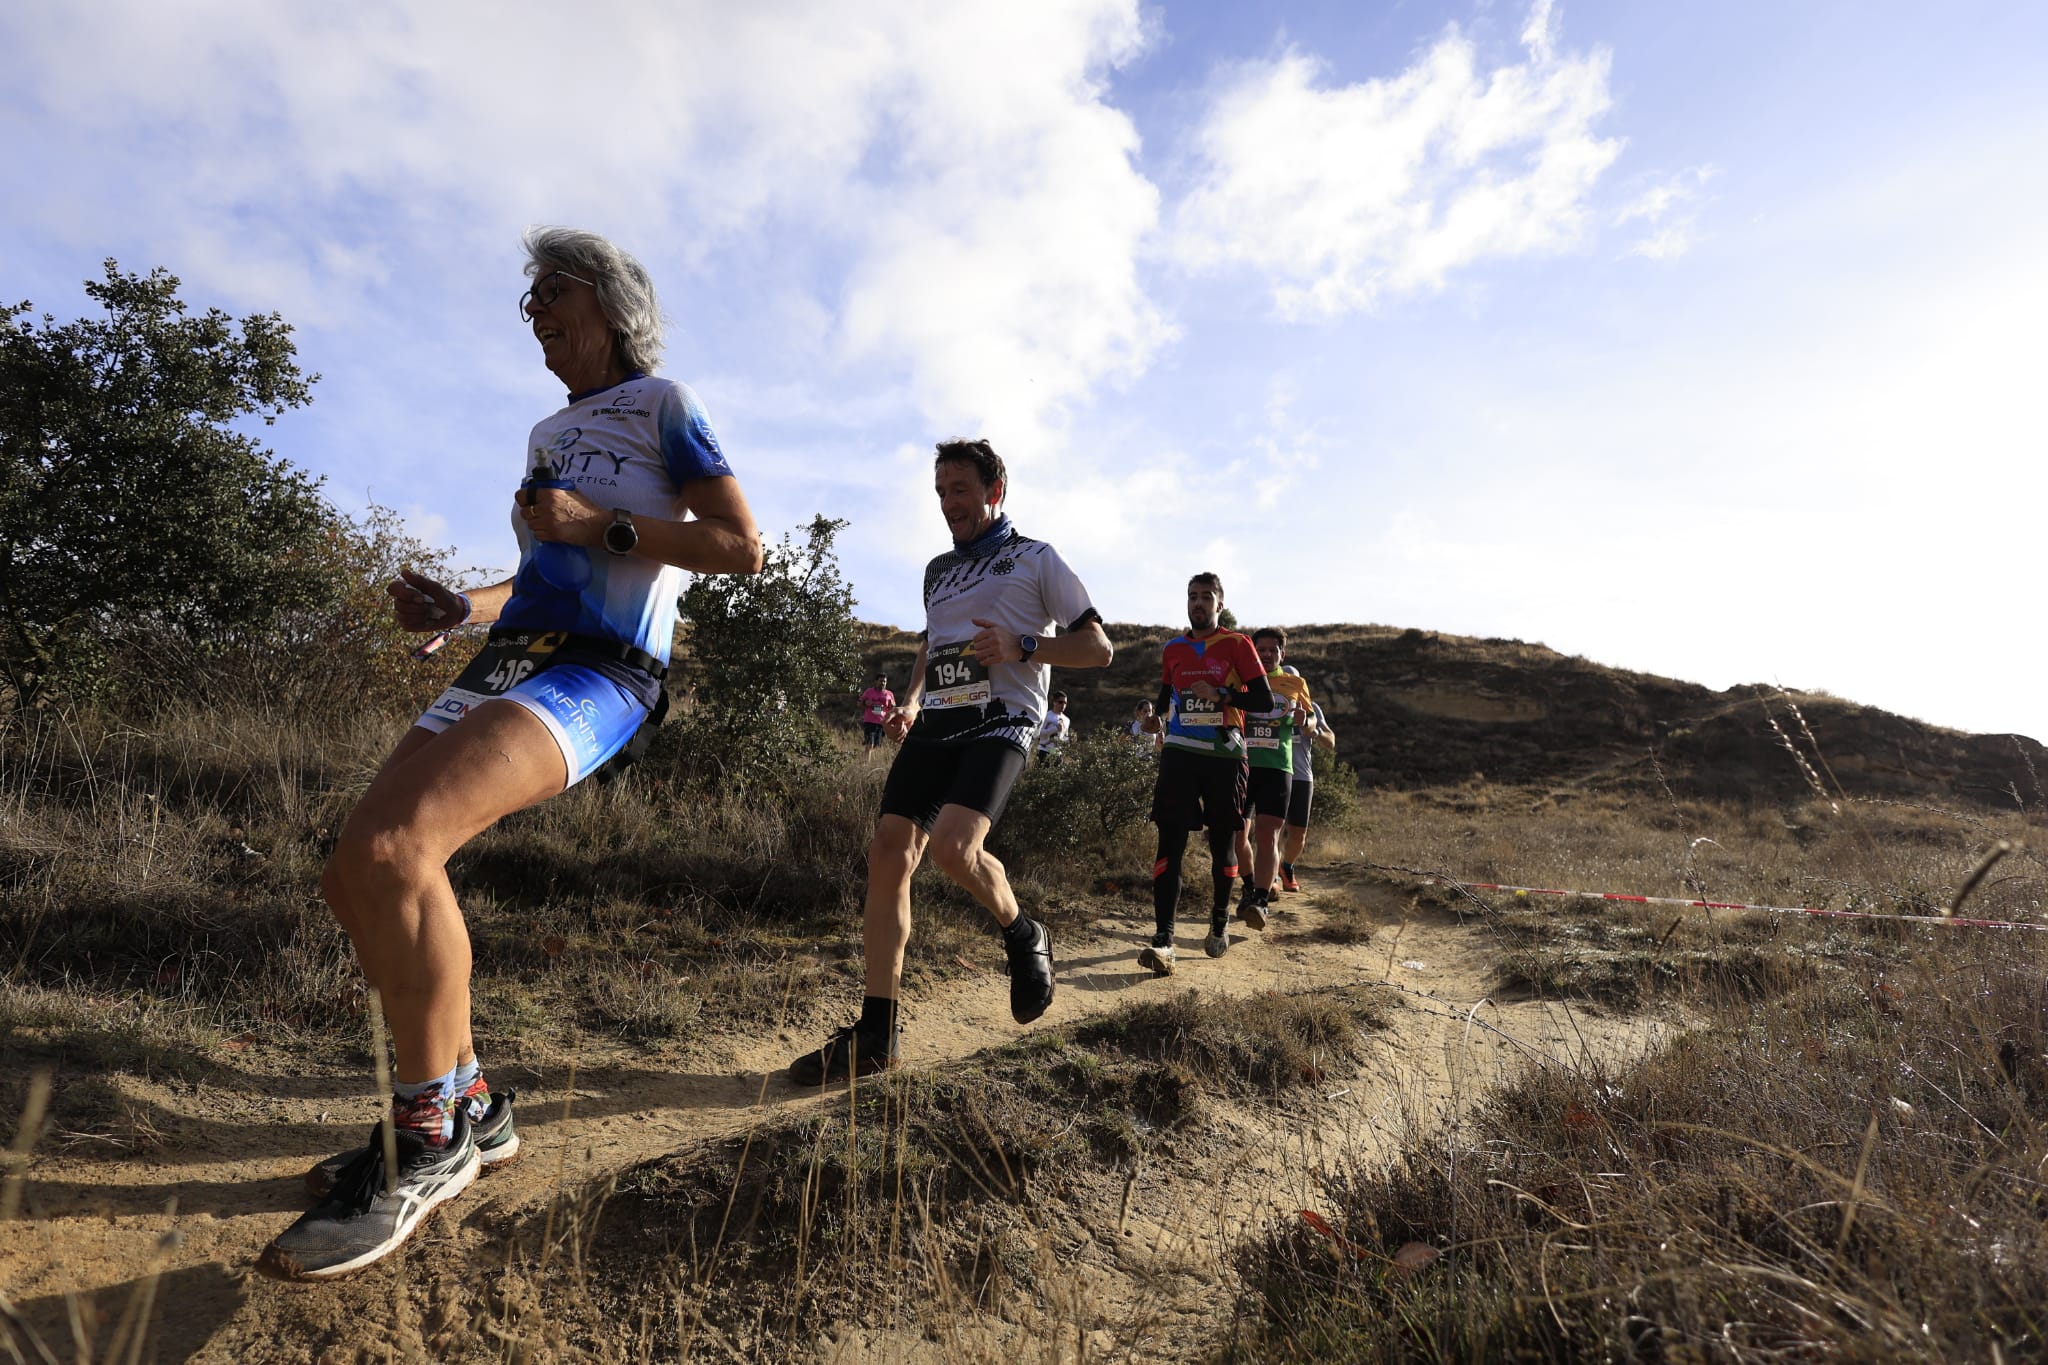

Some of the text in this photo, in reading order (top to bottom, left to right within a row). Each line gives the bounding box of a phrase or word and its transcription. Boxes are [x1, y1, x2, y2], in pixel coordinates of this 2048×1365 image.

[551, 450, 632, 476] NITY
[484, 659, 534, 690] 416
[935, 661, 971, 686] 194
[926, 691, 988, 706] JOMISAGA
[1186, 699, 1215, 711] 644
[541, 684, 599, 754] INFINITY
[1253, 727, 1272, 737] 169
